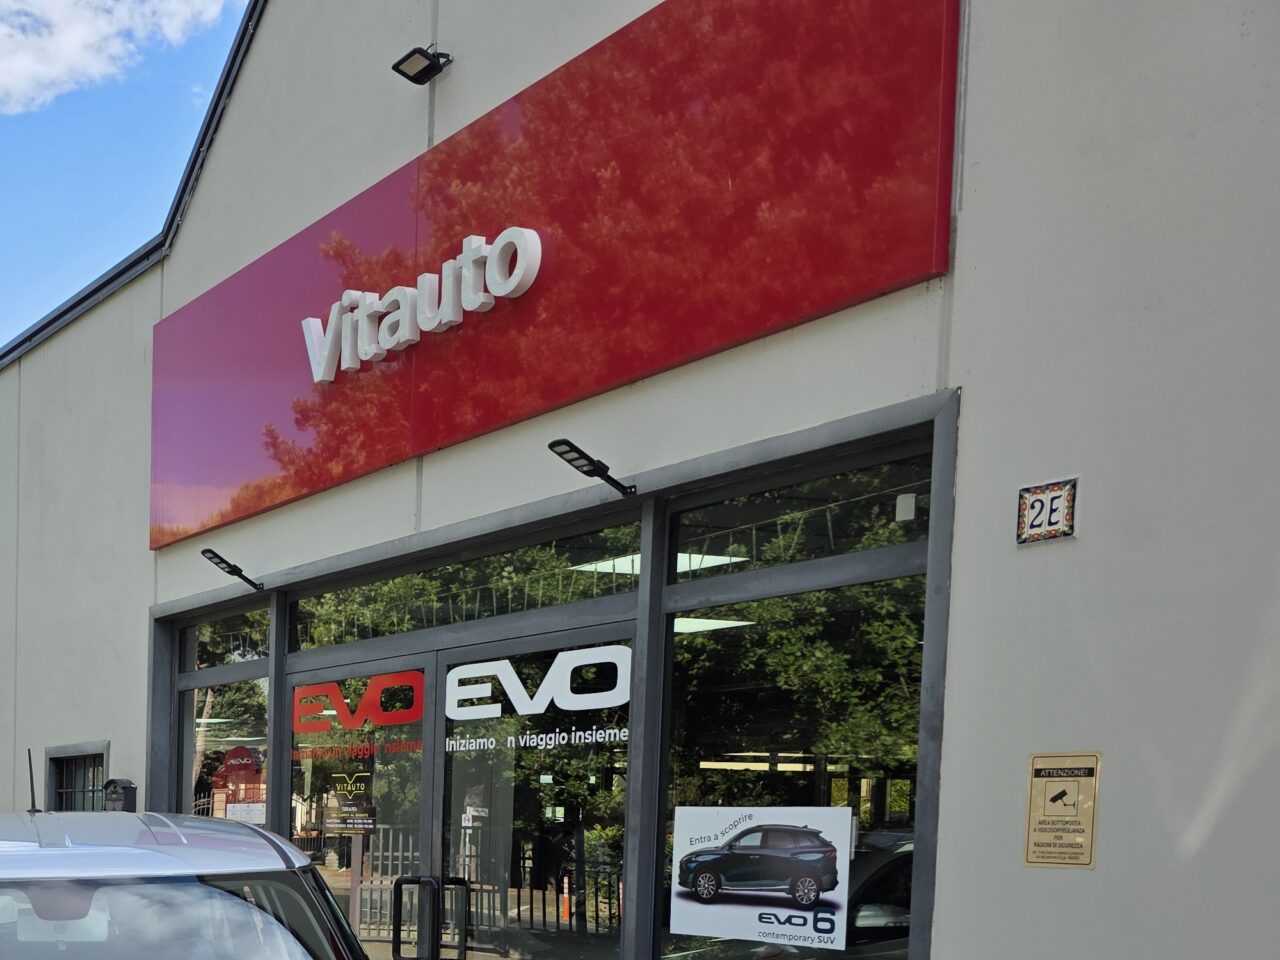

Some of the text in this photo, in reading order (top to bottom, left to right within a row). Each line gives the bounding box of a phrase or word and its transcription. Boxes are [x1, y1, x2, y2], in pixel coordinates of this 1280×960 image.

[301, 226, 542, 384] Vitauto
[1029, 494, 1063, 530] 2E
[445, 644, 633, 721] EVO
[291, 670, 425, 734] EVO
[445, 735, 496, 752] Iniziamo
[519, 728, 568, 750] viaggio
[571, 726, 629, 744] insieme
[335, 783, 366, 791] VITAUTO
[1040, 769, 1089, 777] ATTENZIONE!
[689, 812, 754, 846] Entra a scoprire
[757, 907, 836, 935] EVO 6
[757, 931, 836, 945] contemporary SUV
